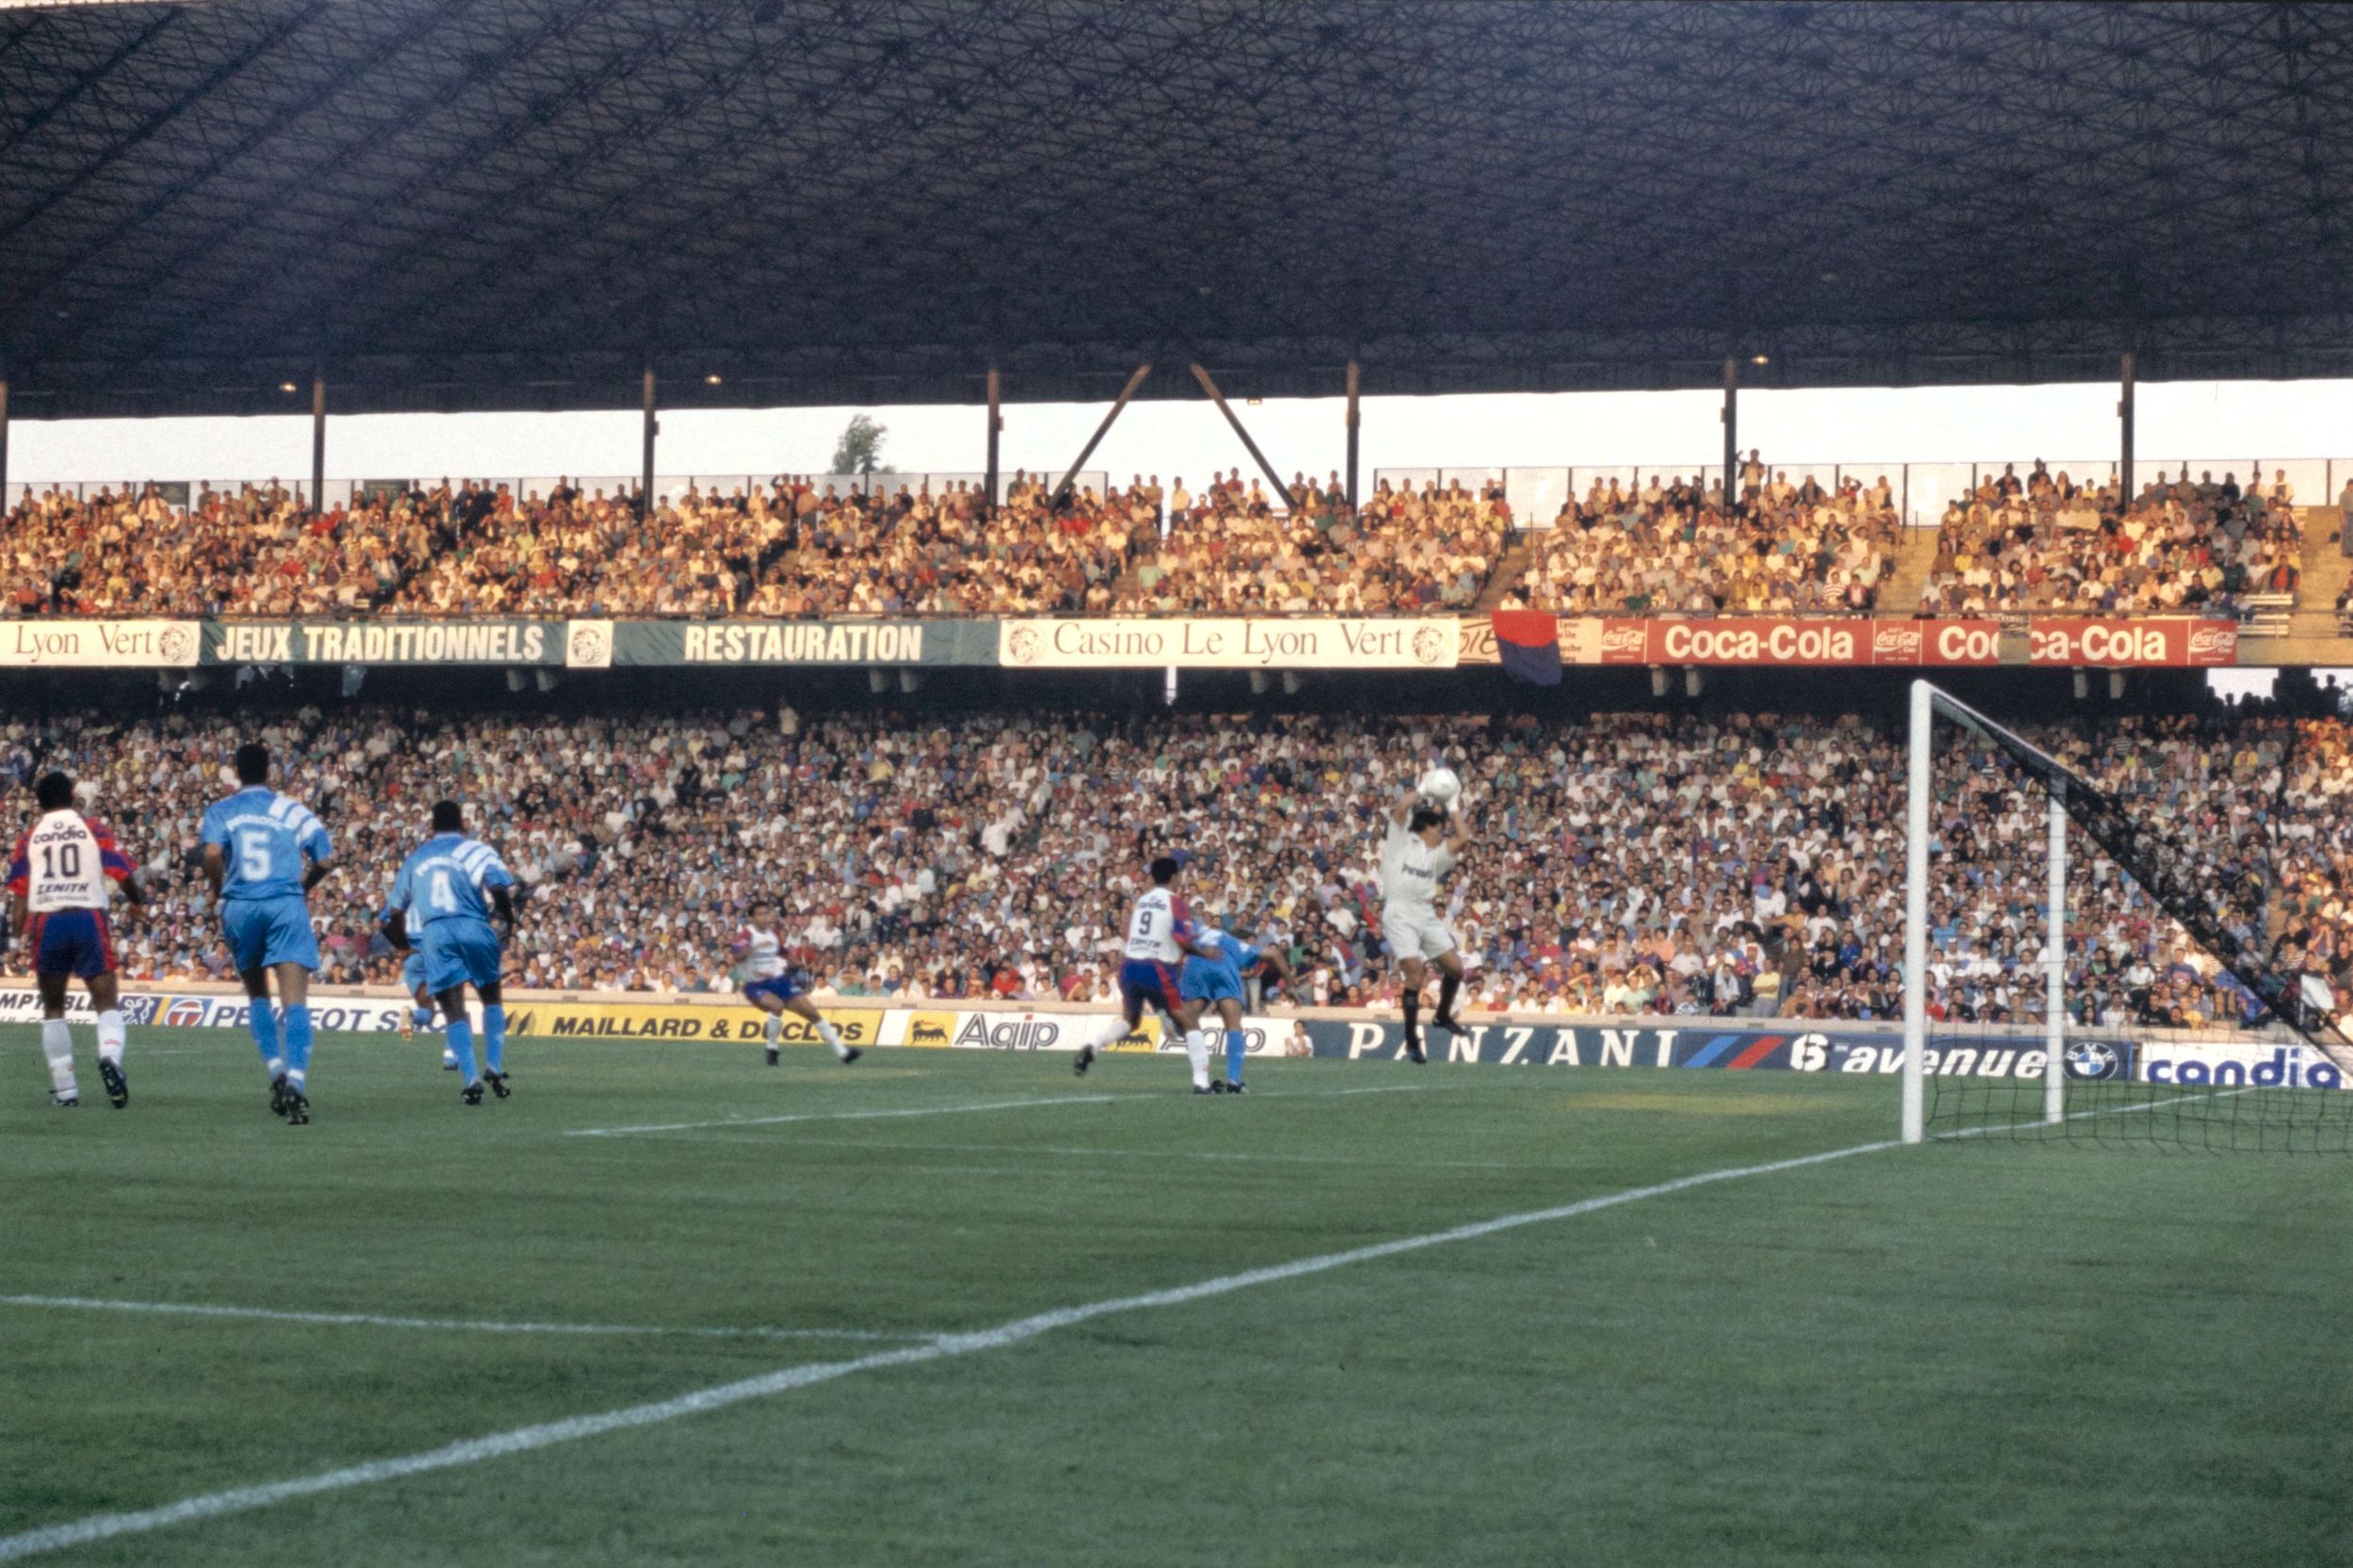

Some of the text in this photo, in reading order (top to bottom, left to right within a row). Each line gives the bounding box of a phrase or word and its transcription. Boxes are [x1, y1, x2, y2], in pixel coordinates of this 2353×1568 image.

[15, 624, 152, 663] Lyon Vert
[216, 625, 543, 661] JEUX TRADITIONNELS
[684, 625, 922, 662] RESTAURATION
[1054, 623, 1404, 664] Casino Le Lyon Vert
[1664, 625, 1853, 660] Coca-Cola
[42, 842, 81, 878] 10
[241, 831, 271, 882] 5
[431, 870, 457, 914] 4
[1139, 910, 1153, 936] 9
[552, 1016, 701, 1040] MAILLARD
[710, 1019, 731, 1039] &
[955, 1013, 1060, 1049] Agip
[1348, 1022, 1678, 1069] PANZANI
[1790, 1032, 2048, 1080] 6 avenue
[2147, 1047, 2342, 1090] candia
